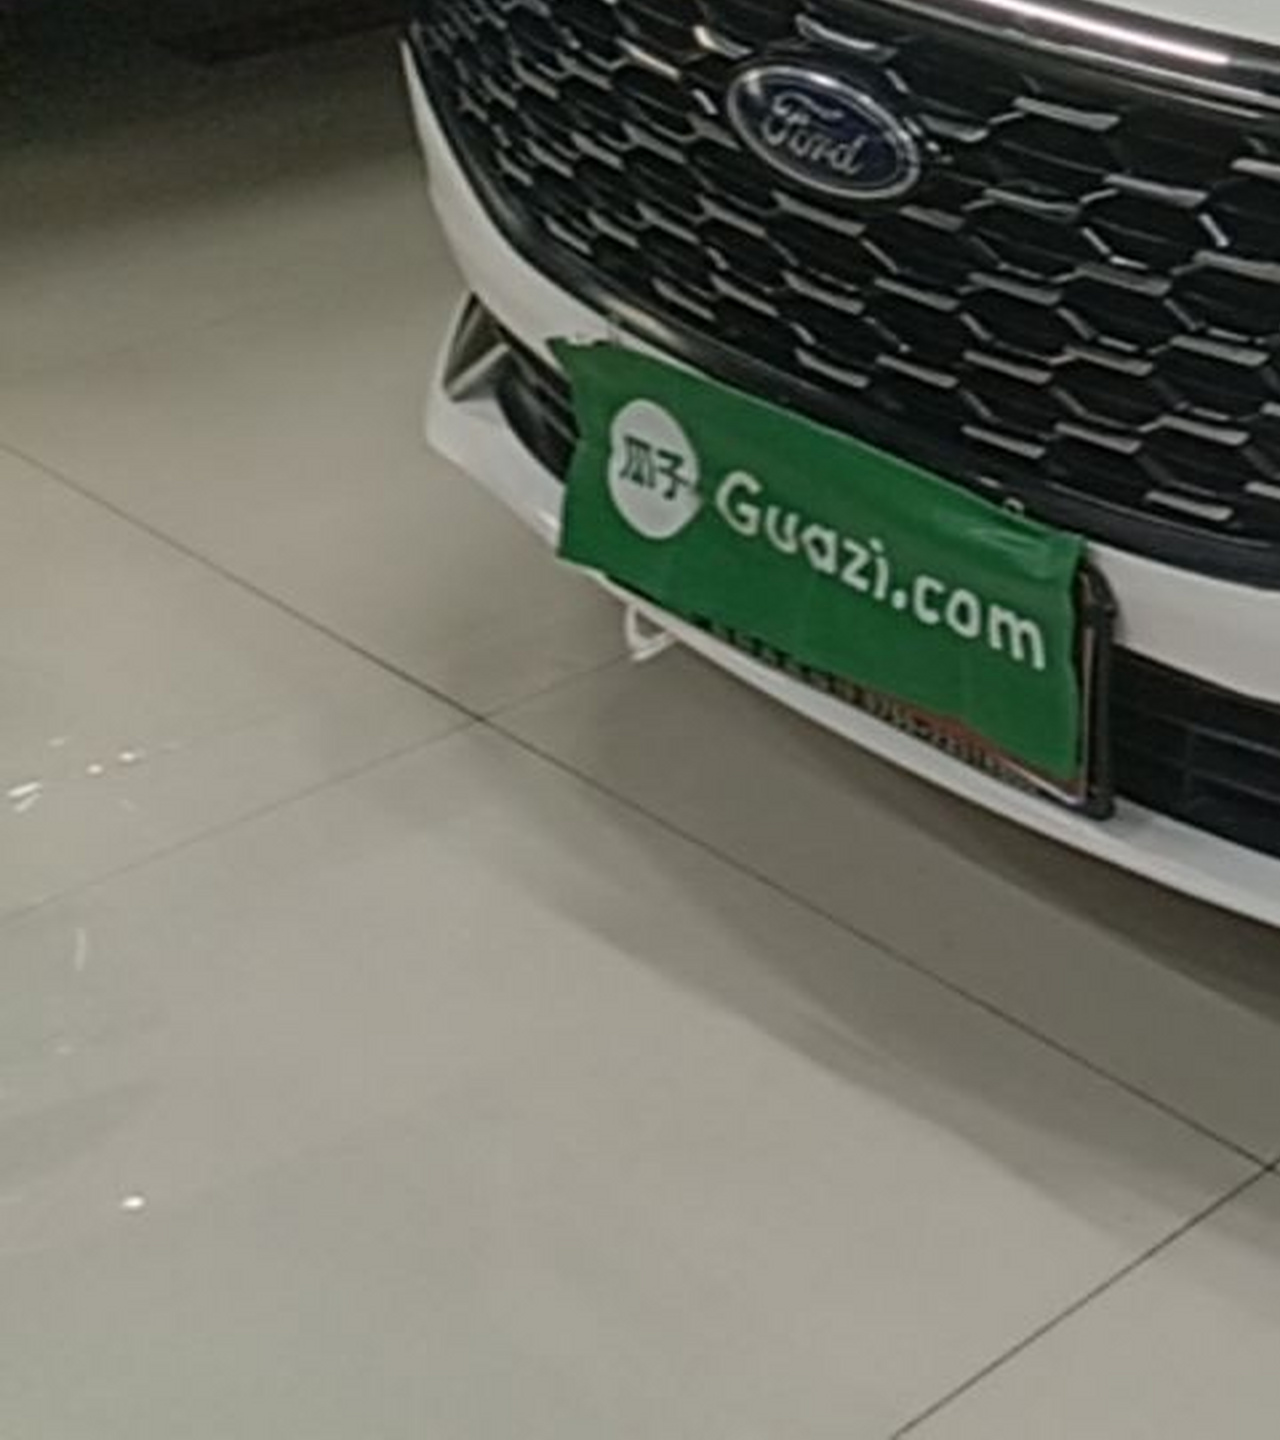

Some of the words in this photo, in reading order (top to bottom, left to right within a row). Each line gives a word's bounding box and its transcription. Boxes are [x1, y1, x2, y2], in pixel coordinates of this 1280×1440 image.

[761, 92, 866, 176] Ford
[619, 436, 696, 500] 瓜子
[715, 470, 1047, 672] Guazi.com
